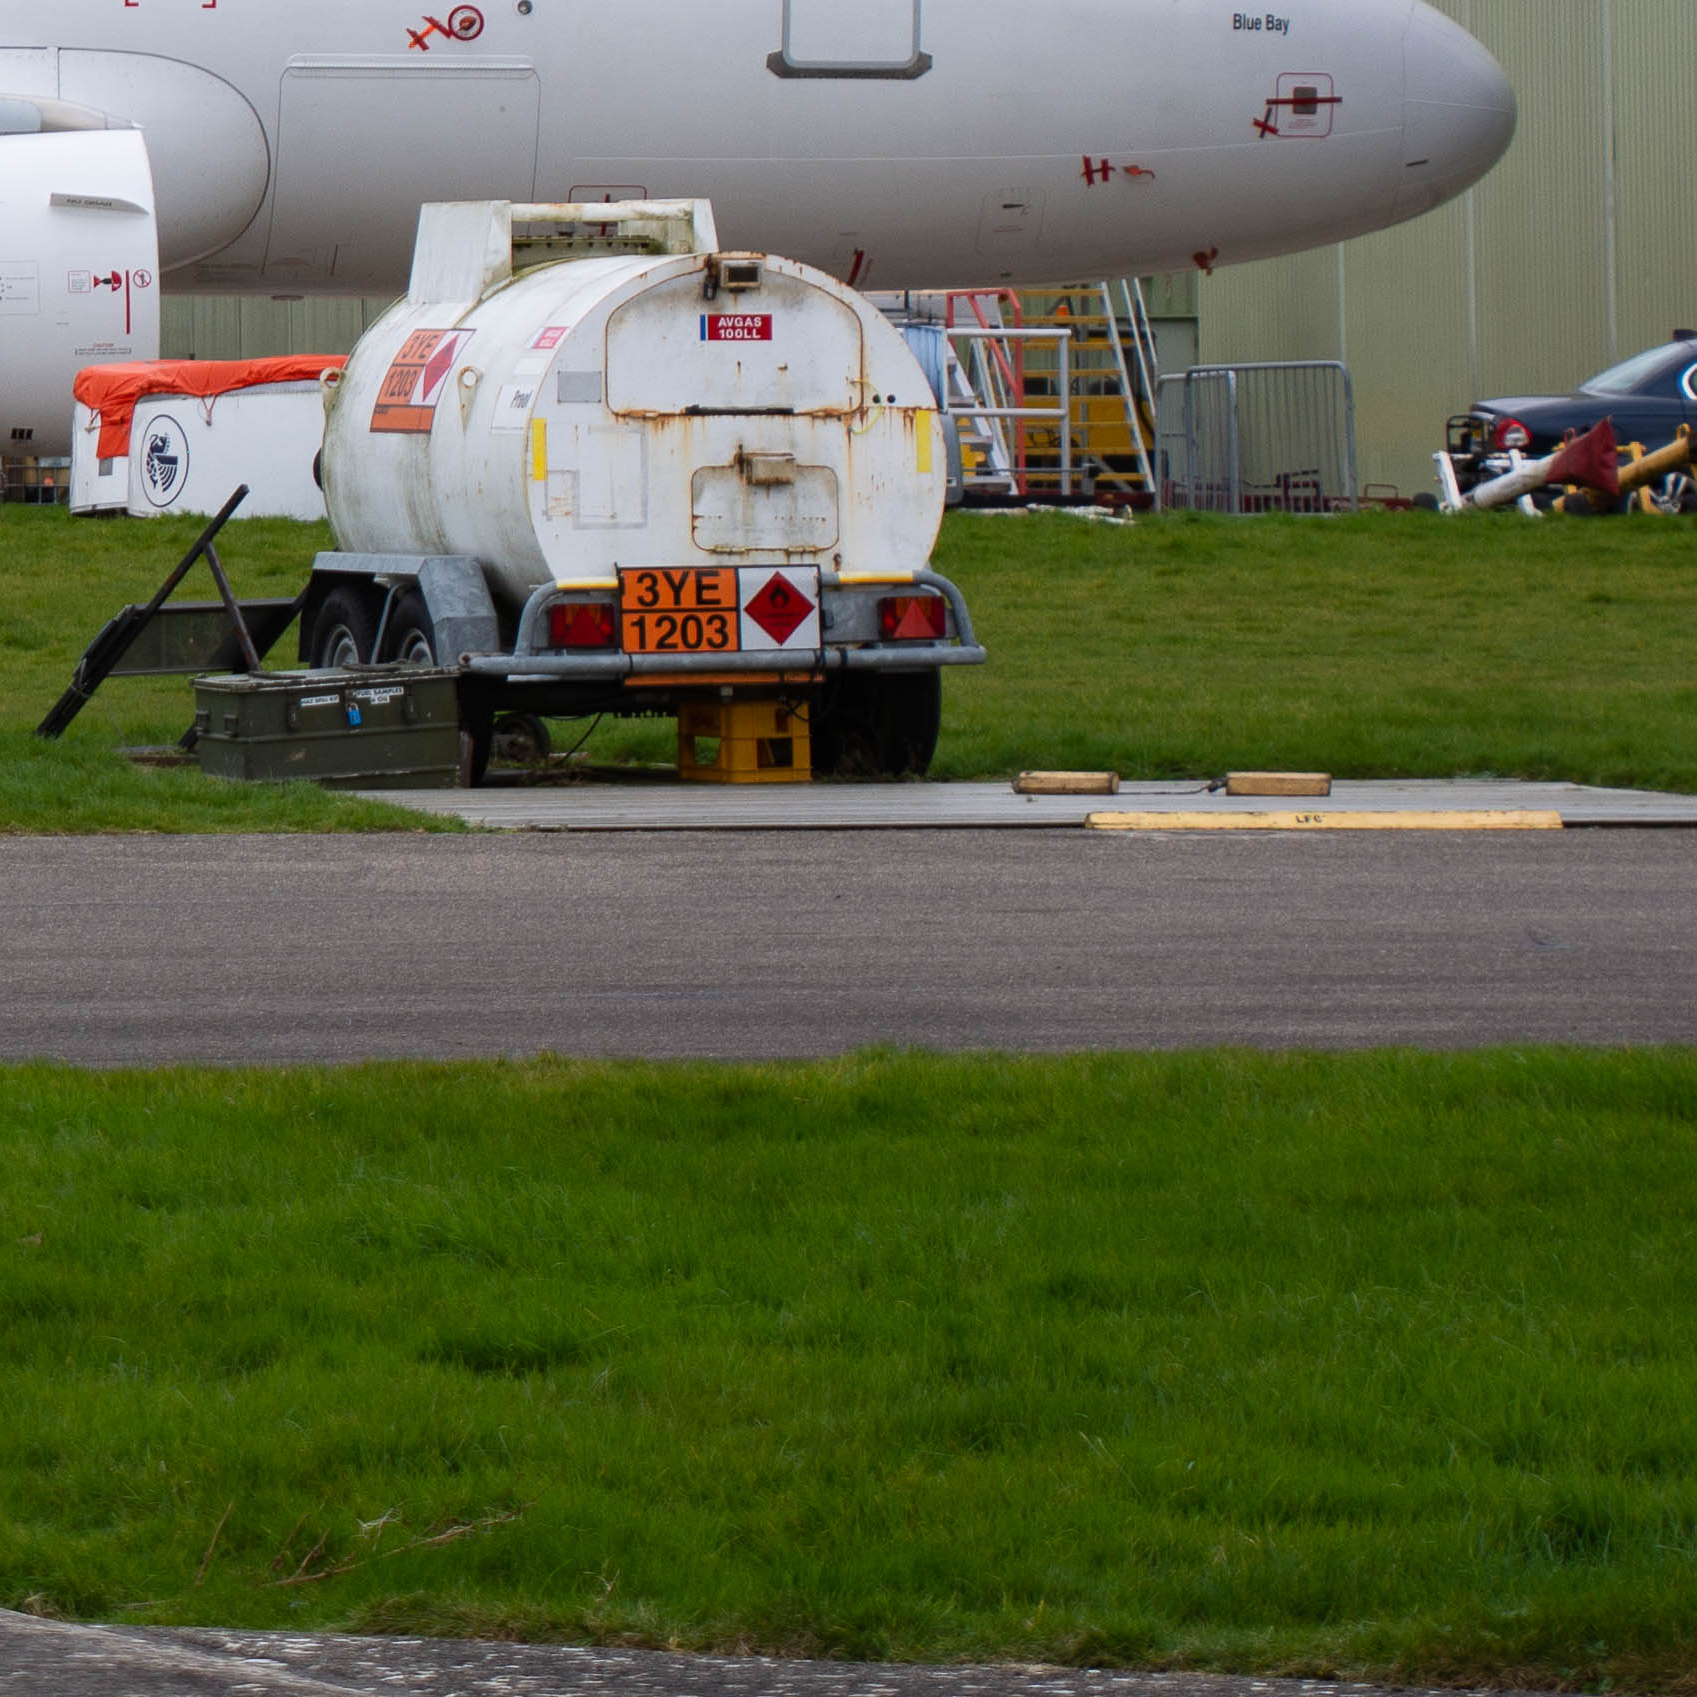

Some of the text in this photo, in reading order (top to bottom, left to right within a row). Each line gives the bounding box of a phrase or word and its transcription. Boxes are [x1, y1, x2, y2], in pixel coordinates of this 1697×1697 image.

[1233, 13, 1290, 36] Blue Bay
[718, 317, 762, 327] AVGAS
[718, 328, 762, 339] 100LL
[402, 334, 440, 359] 3YE
[385, 370, 418, 398] 1203
[636, 570, 722, 607] 3YE
[630, 614, 730, 650] 1203
